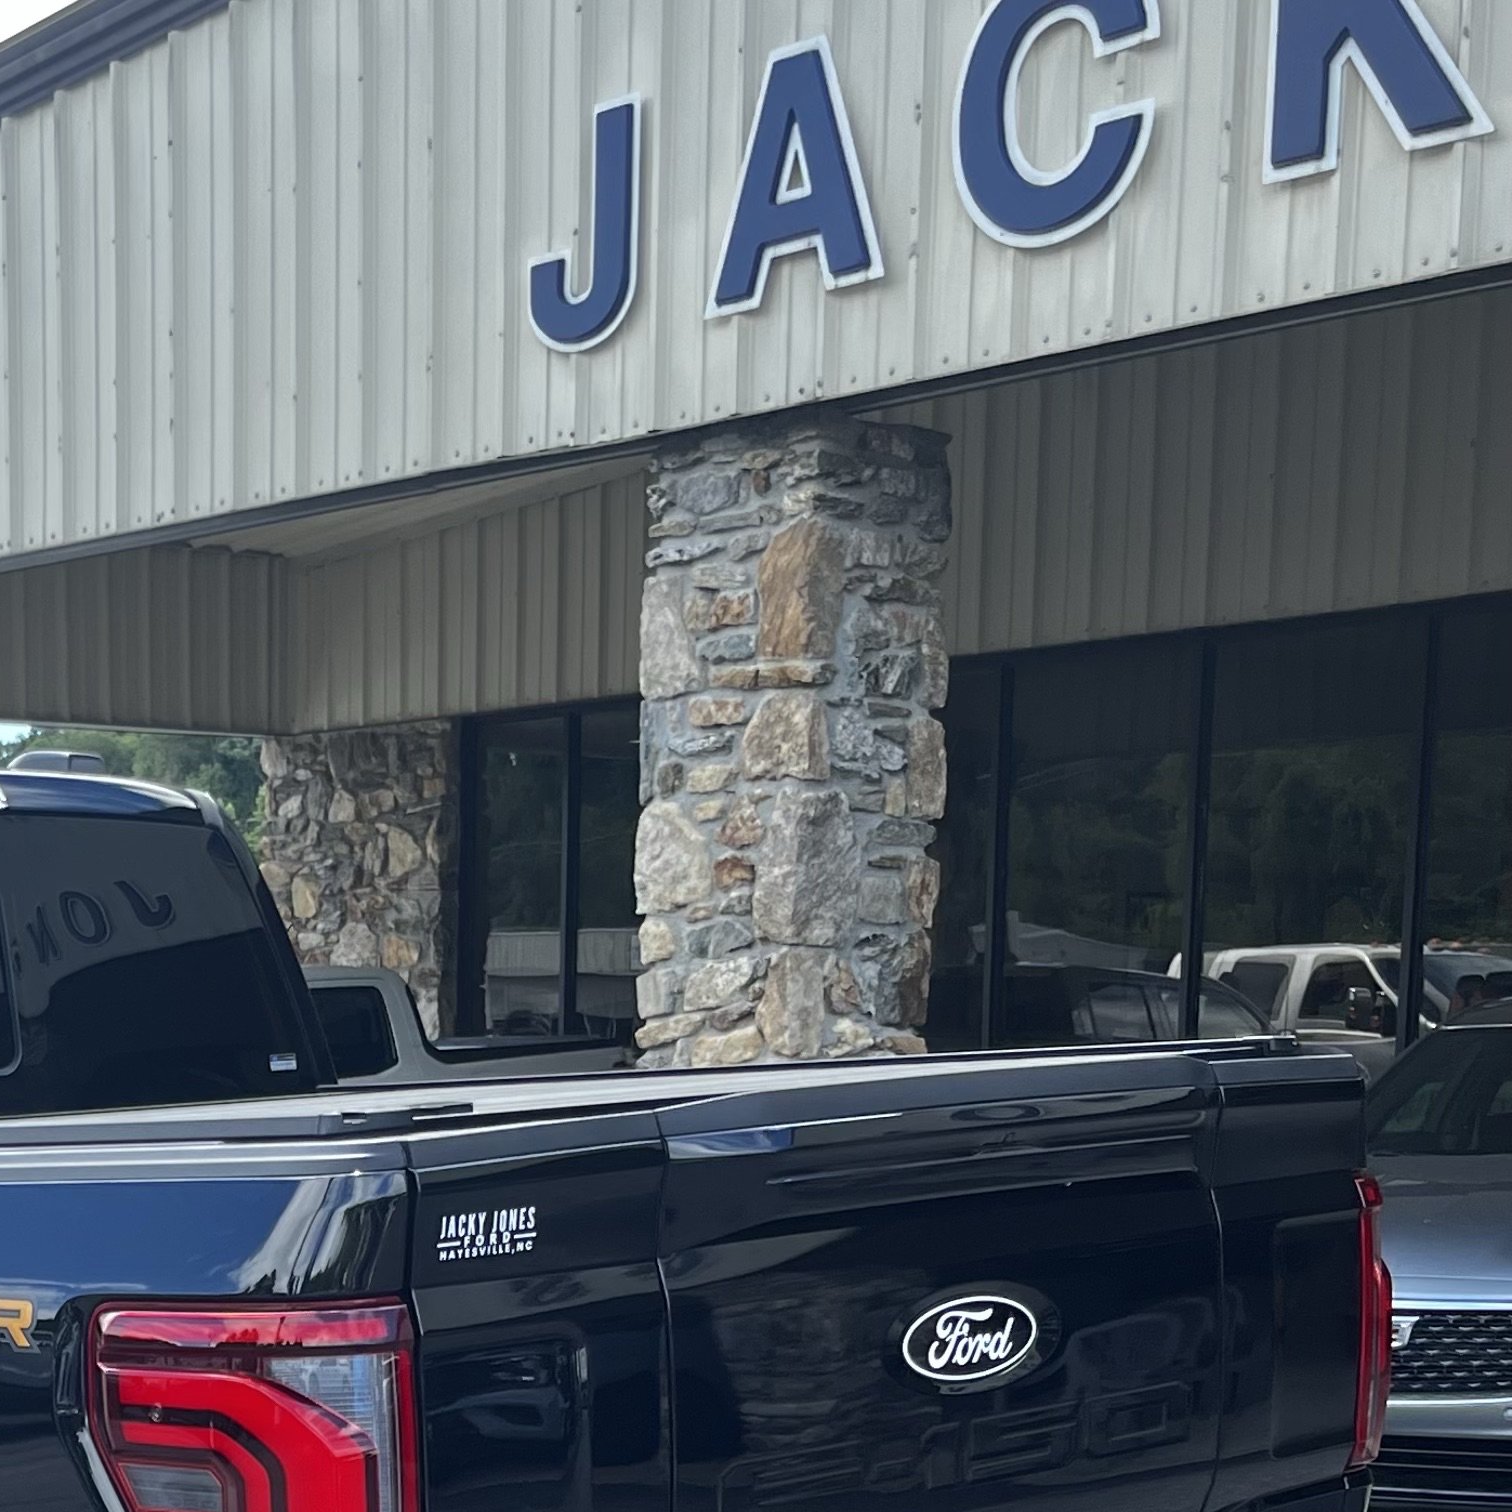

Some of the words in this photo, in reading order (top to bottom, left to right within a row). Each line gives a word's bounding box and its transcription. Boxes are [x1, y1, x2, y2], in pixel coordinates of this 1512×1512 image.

[440, 1211, 487, 1240] JACKY
[491, 1206, 536, 1233] JONES
[463, 1231, 511, 1248] FORD
[928, 1307, 1015, 1370] Ford
